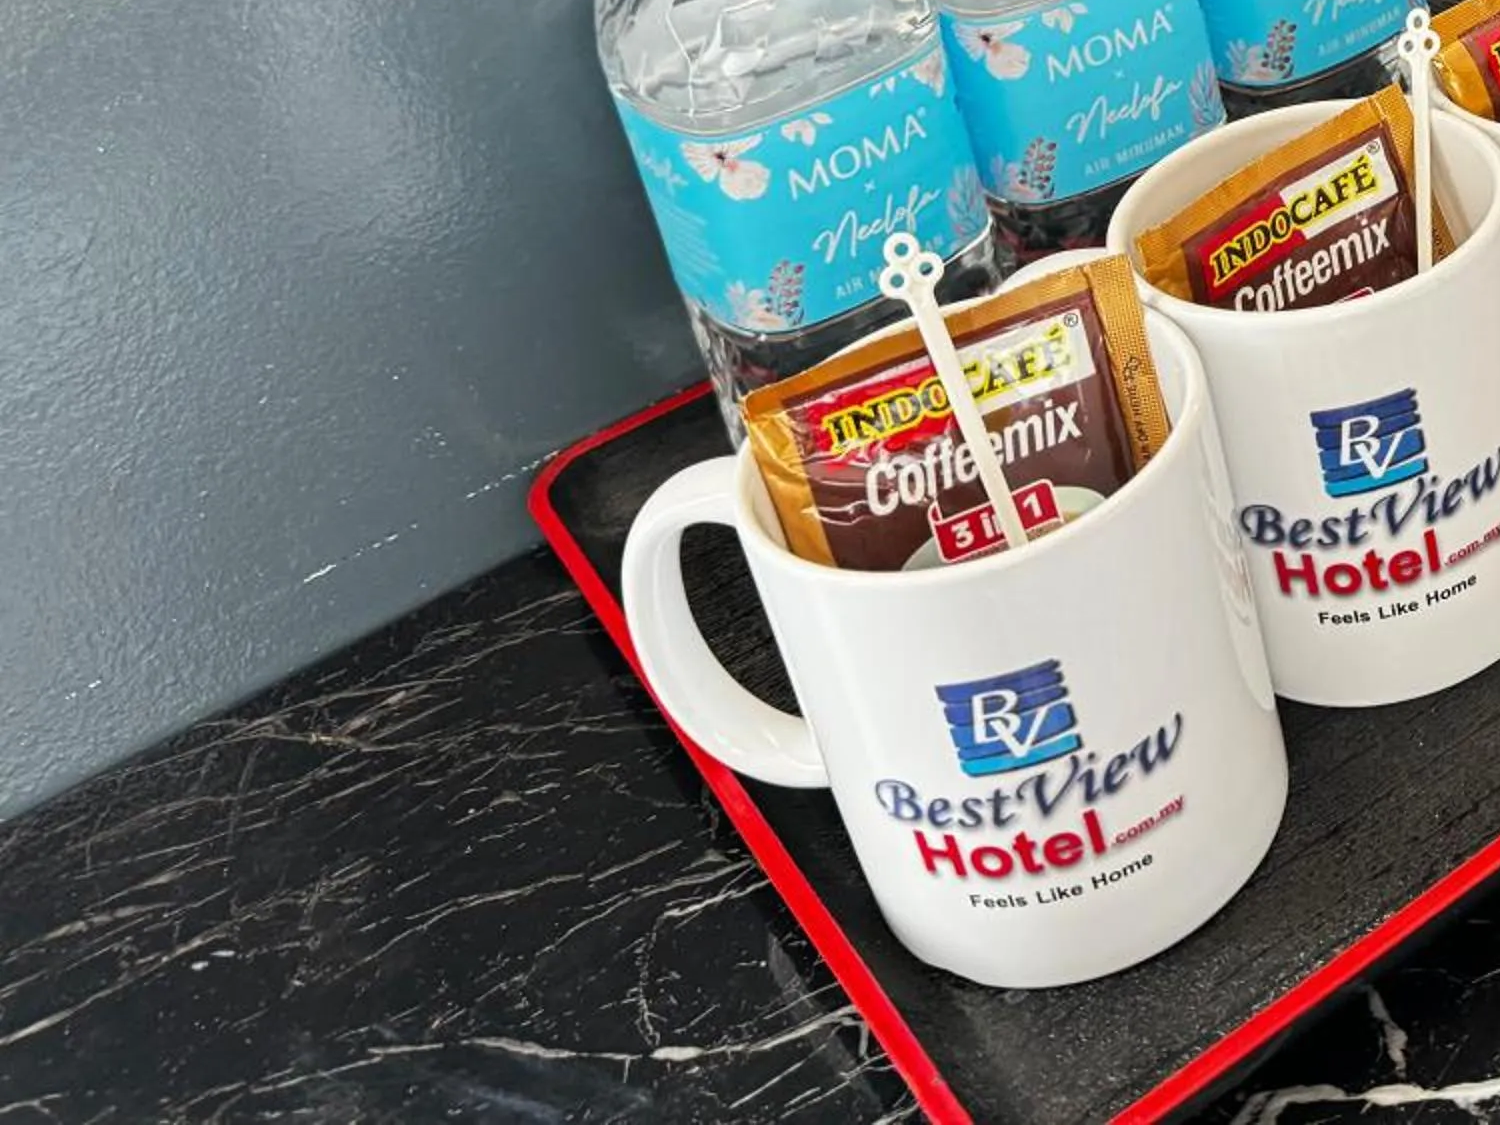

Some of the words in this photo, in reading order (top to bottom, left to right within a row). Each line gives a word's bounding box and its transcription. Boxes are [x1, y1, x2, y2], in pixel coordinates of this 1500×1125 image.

[1047, 9, 1173, 83] MOMA
[788, 114, 927, 200] MOMA
[1212, 154, 1376, 282] INDOCAFÉ
[1235, 218, 1391, 312] Coffeemix
[950, 520, 975, 549] 3
[1022, 492, 1043, 519] 1
[1273, 528, 1442, 597] Hotel
[1318, 610, 1371, 626] Feels
[1378, 600, 1420, 620] Like
[1426, 574, 1478, 606] Home
[913, 808, 1108, 881] Hotel
[969, 893, 1028, 909] Feels
[1035, 884, 1084, 905] Like
[1092, 853, 1154, 890] Home
